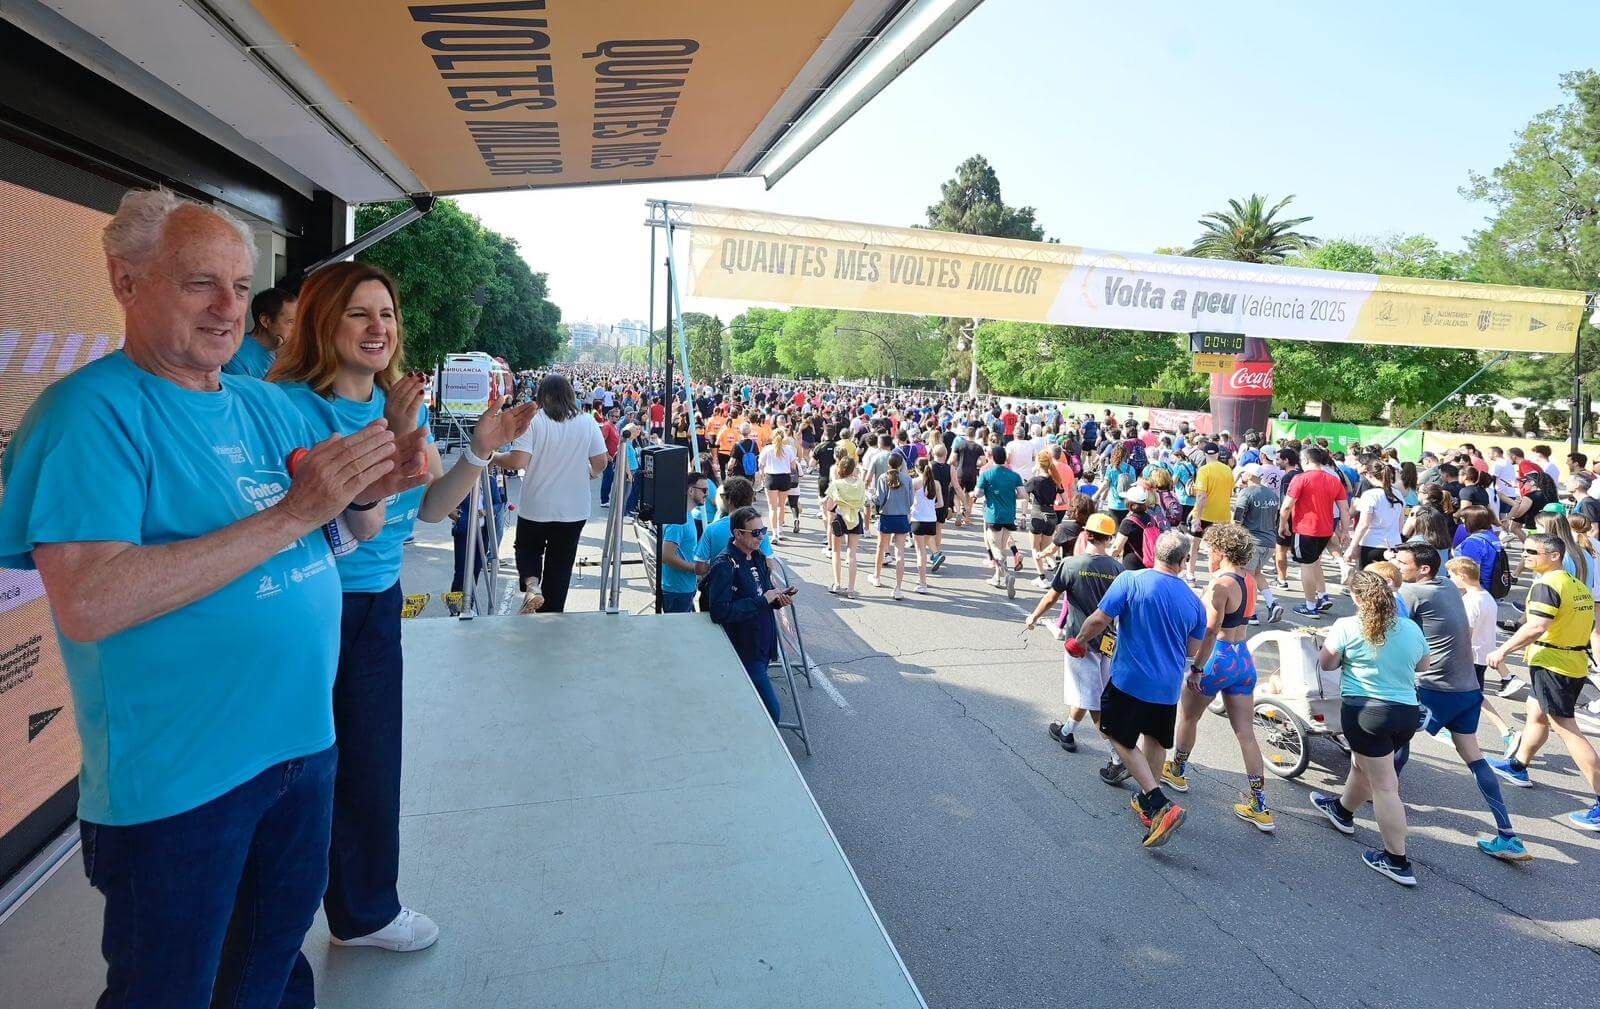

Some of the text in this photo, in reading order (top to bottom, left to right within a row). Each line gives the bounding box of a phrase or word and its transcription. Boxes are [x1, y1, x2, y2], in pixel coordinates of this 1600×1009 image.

[407, 0, 564, 176] VOLTES MILLOR
[582, 38, 700, 170] QUANTES MÉS
[720, 238, 1042, 295] QUANTES MÉS VOLTES MILLOR
[1104, 275, 1347, 323] Volta a peu València 2025
[244, 482, 284, 500] Volta
